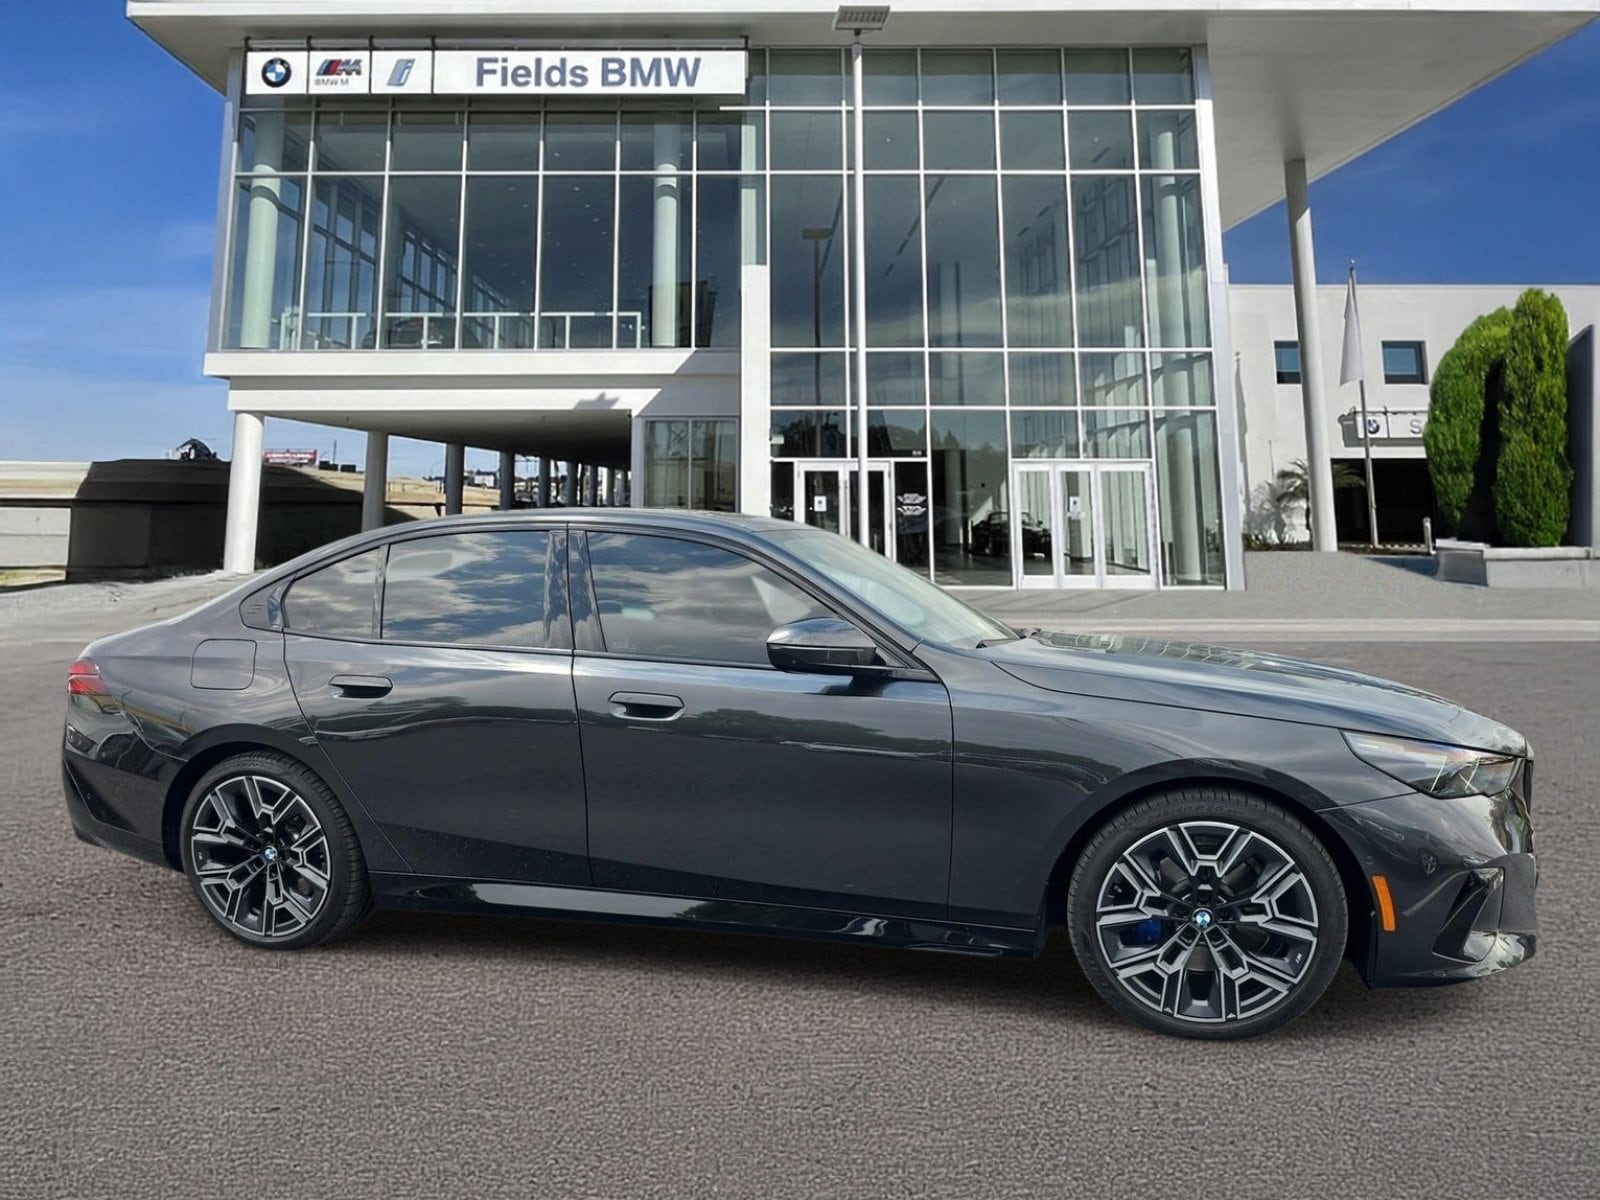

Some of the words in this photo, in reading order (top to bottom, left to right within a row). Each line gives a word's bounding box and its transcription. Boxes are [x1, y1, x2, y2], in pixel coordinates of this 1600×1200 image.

[475, 57, 589, 87] Fields
[601, 57, 702, 87] BMW
[315, 78, 338, 86] BMW
